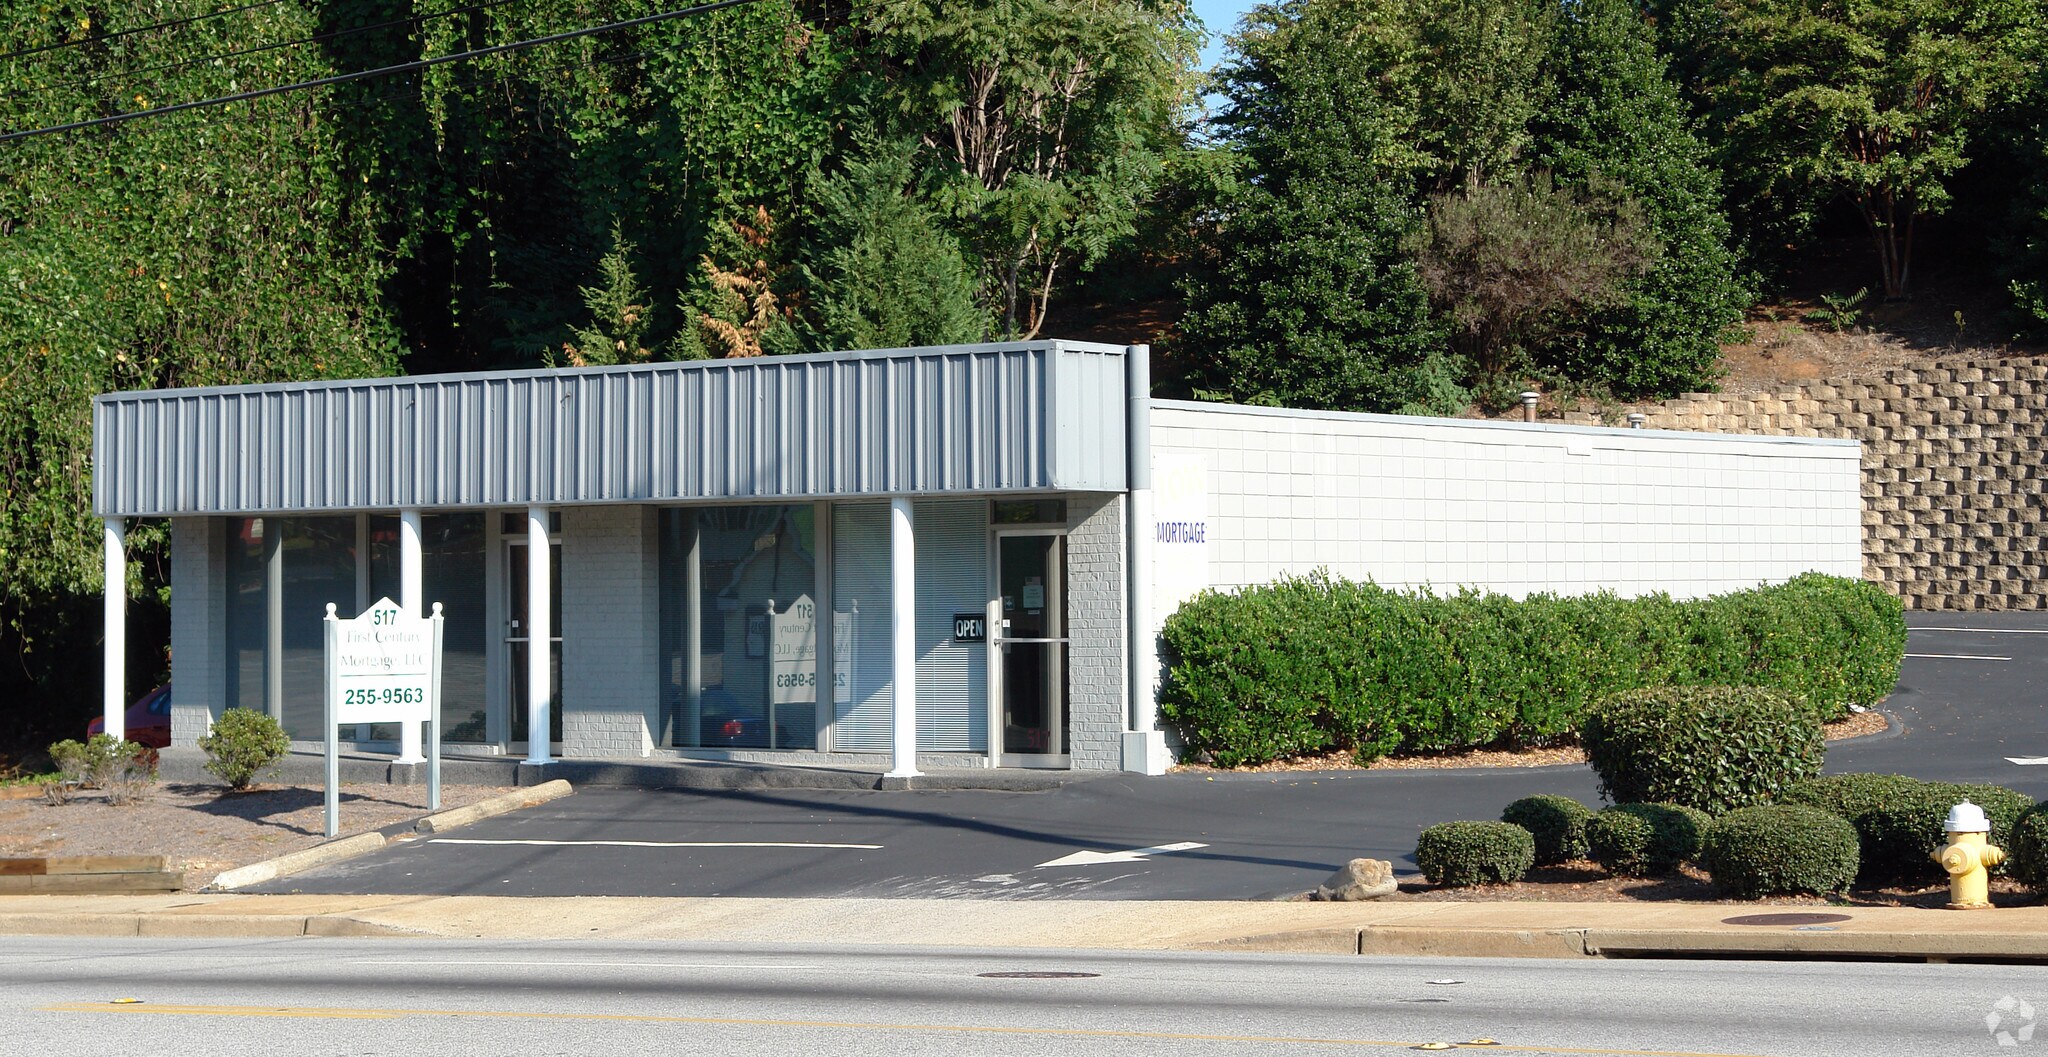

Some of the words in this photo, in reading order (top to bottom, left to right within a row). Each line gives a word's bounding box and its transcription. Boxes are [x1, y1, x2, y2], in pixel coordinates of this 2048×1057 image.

[1156, 522, 1205, 543] MORTGAGE
[374, 609, 397, 626] 517
[956, 619, 983, 637] OPEN
[346, 629, 371, 643] First
[375, 630, 420, 645] Century
[405, 653, 425, 666] LLC
[345, 688, 423, 705] 255-9563
